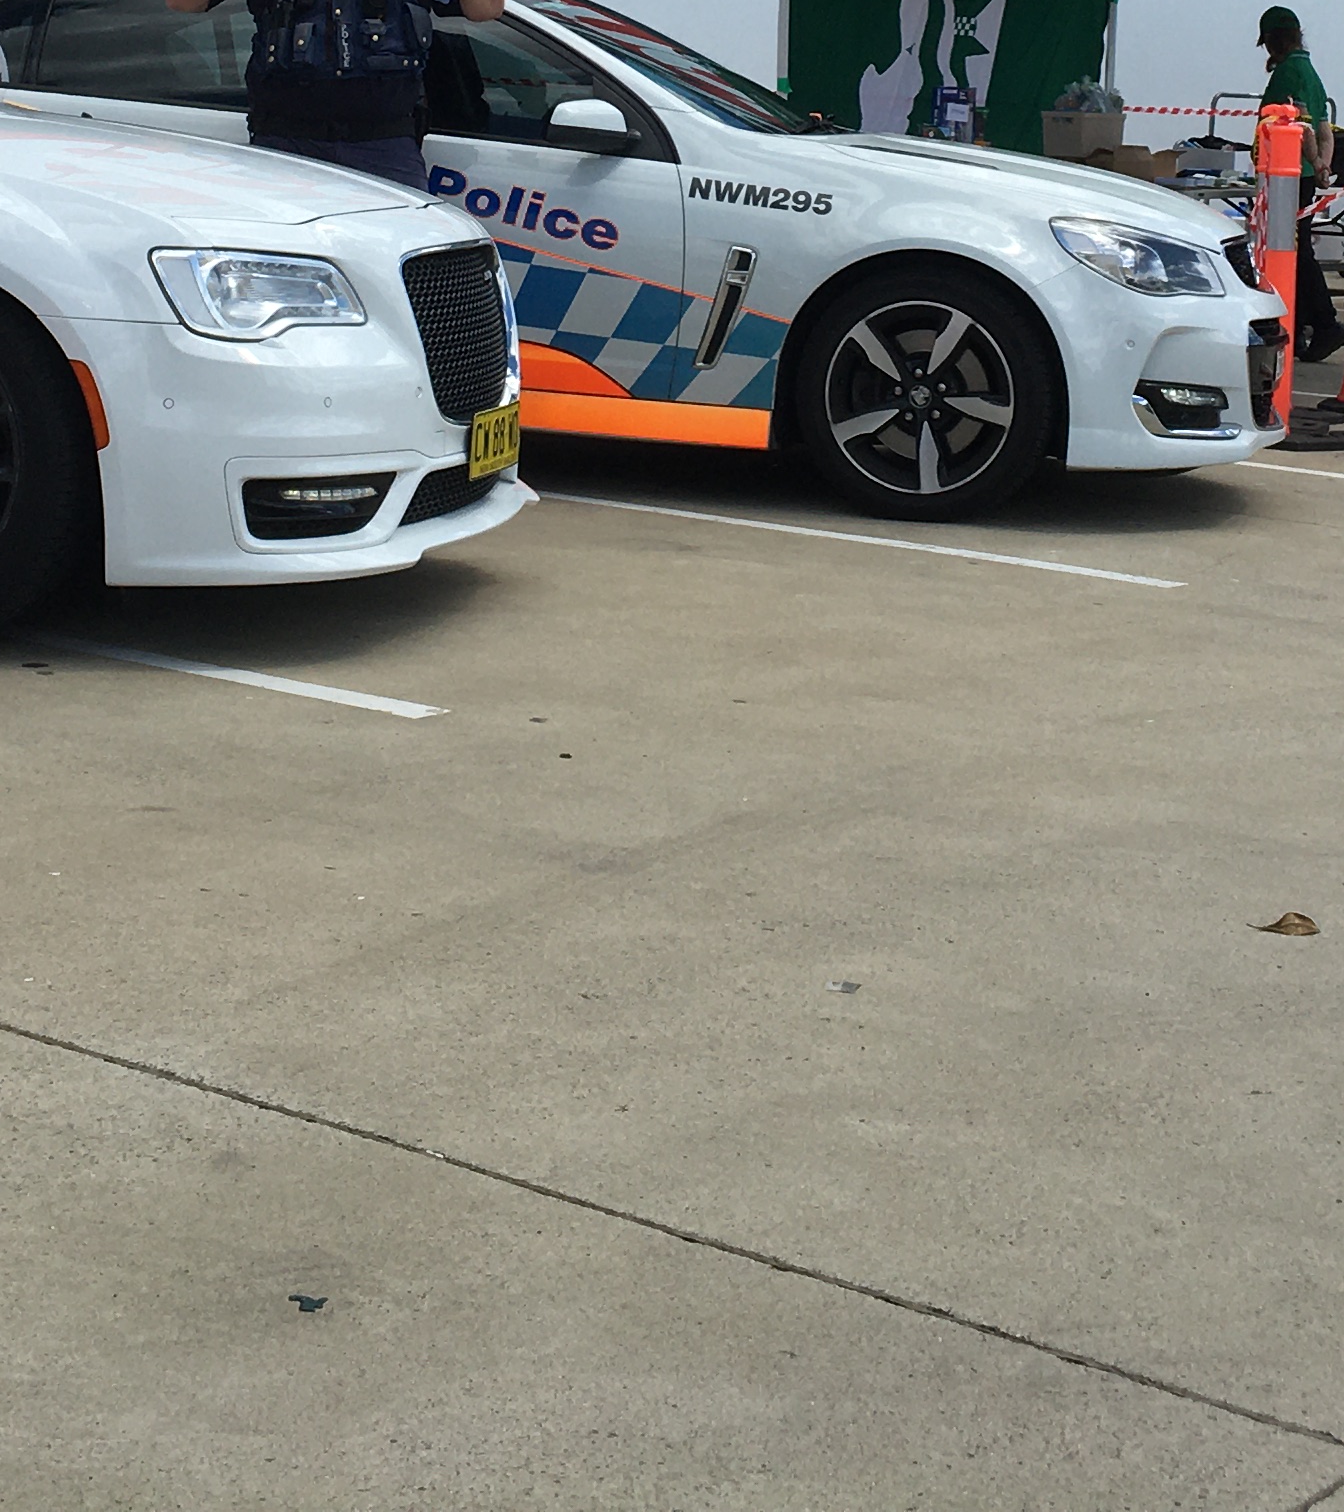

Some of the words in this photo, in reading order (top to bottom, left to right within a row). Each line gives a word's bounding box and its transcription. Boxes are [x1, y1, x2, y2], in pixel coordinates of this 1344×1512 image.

[341, 24, 351, 68] POLICE
[428, 164, 620, 251] Police
[687, 176, 834, 216] NWM295
